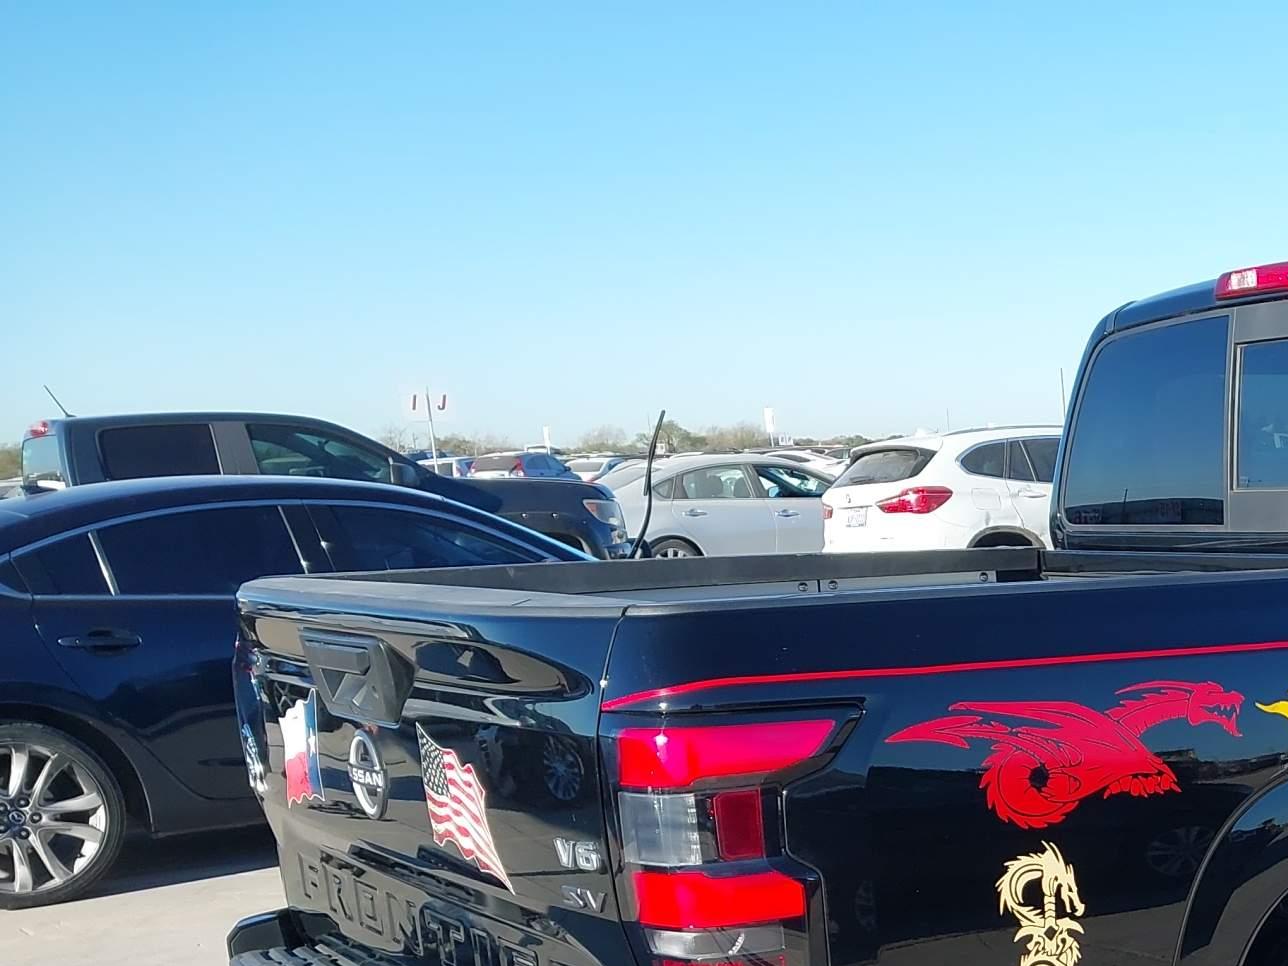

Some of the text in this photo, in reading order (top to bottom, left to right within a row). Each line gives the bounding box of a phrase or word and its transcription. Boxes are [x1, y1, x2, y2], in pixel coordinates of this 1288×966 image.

[436, 393, 447, 411] J
[348, 765, 383, 787] SSAN
[552, 835, 601, 871] V6
[561, 884, 607, 914] SV
